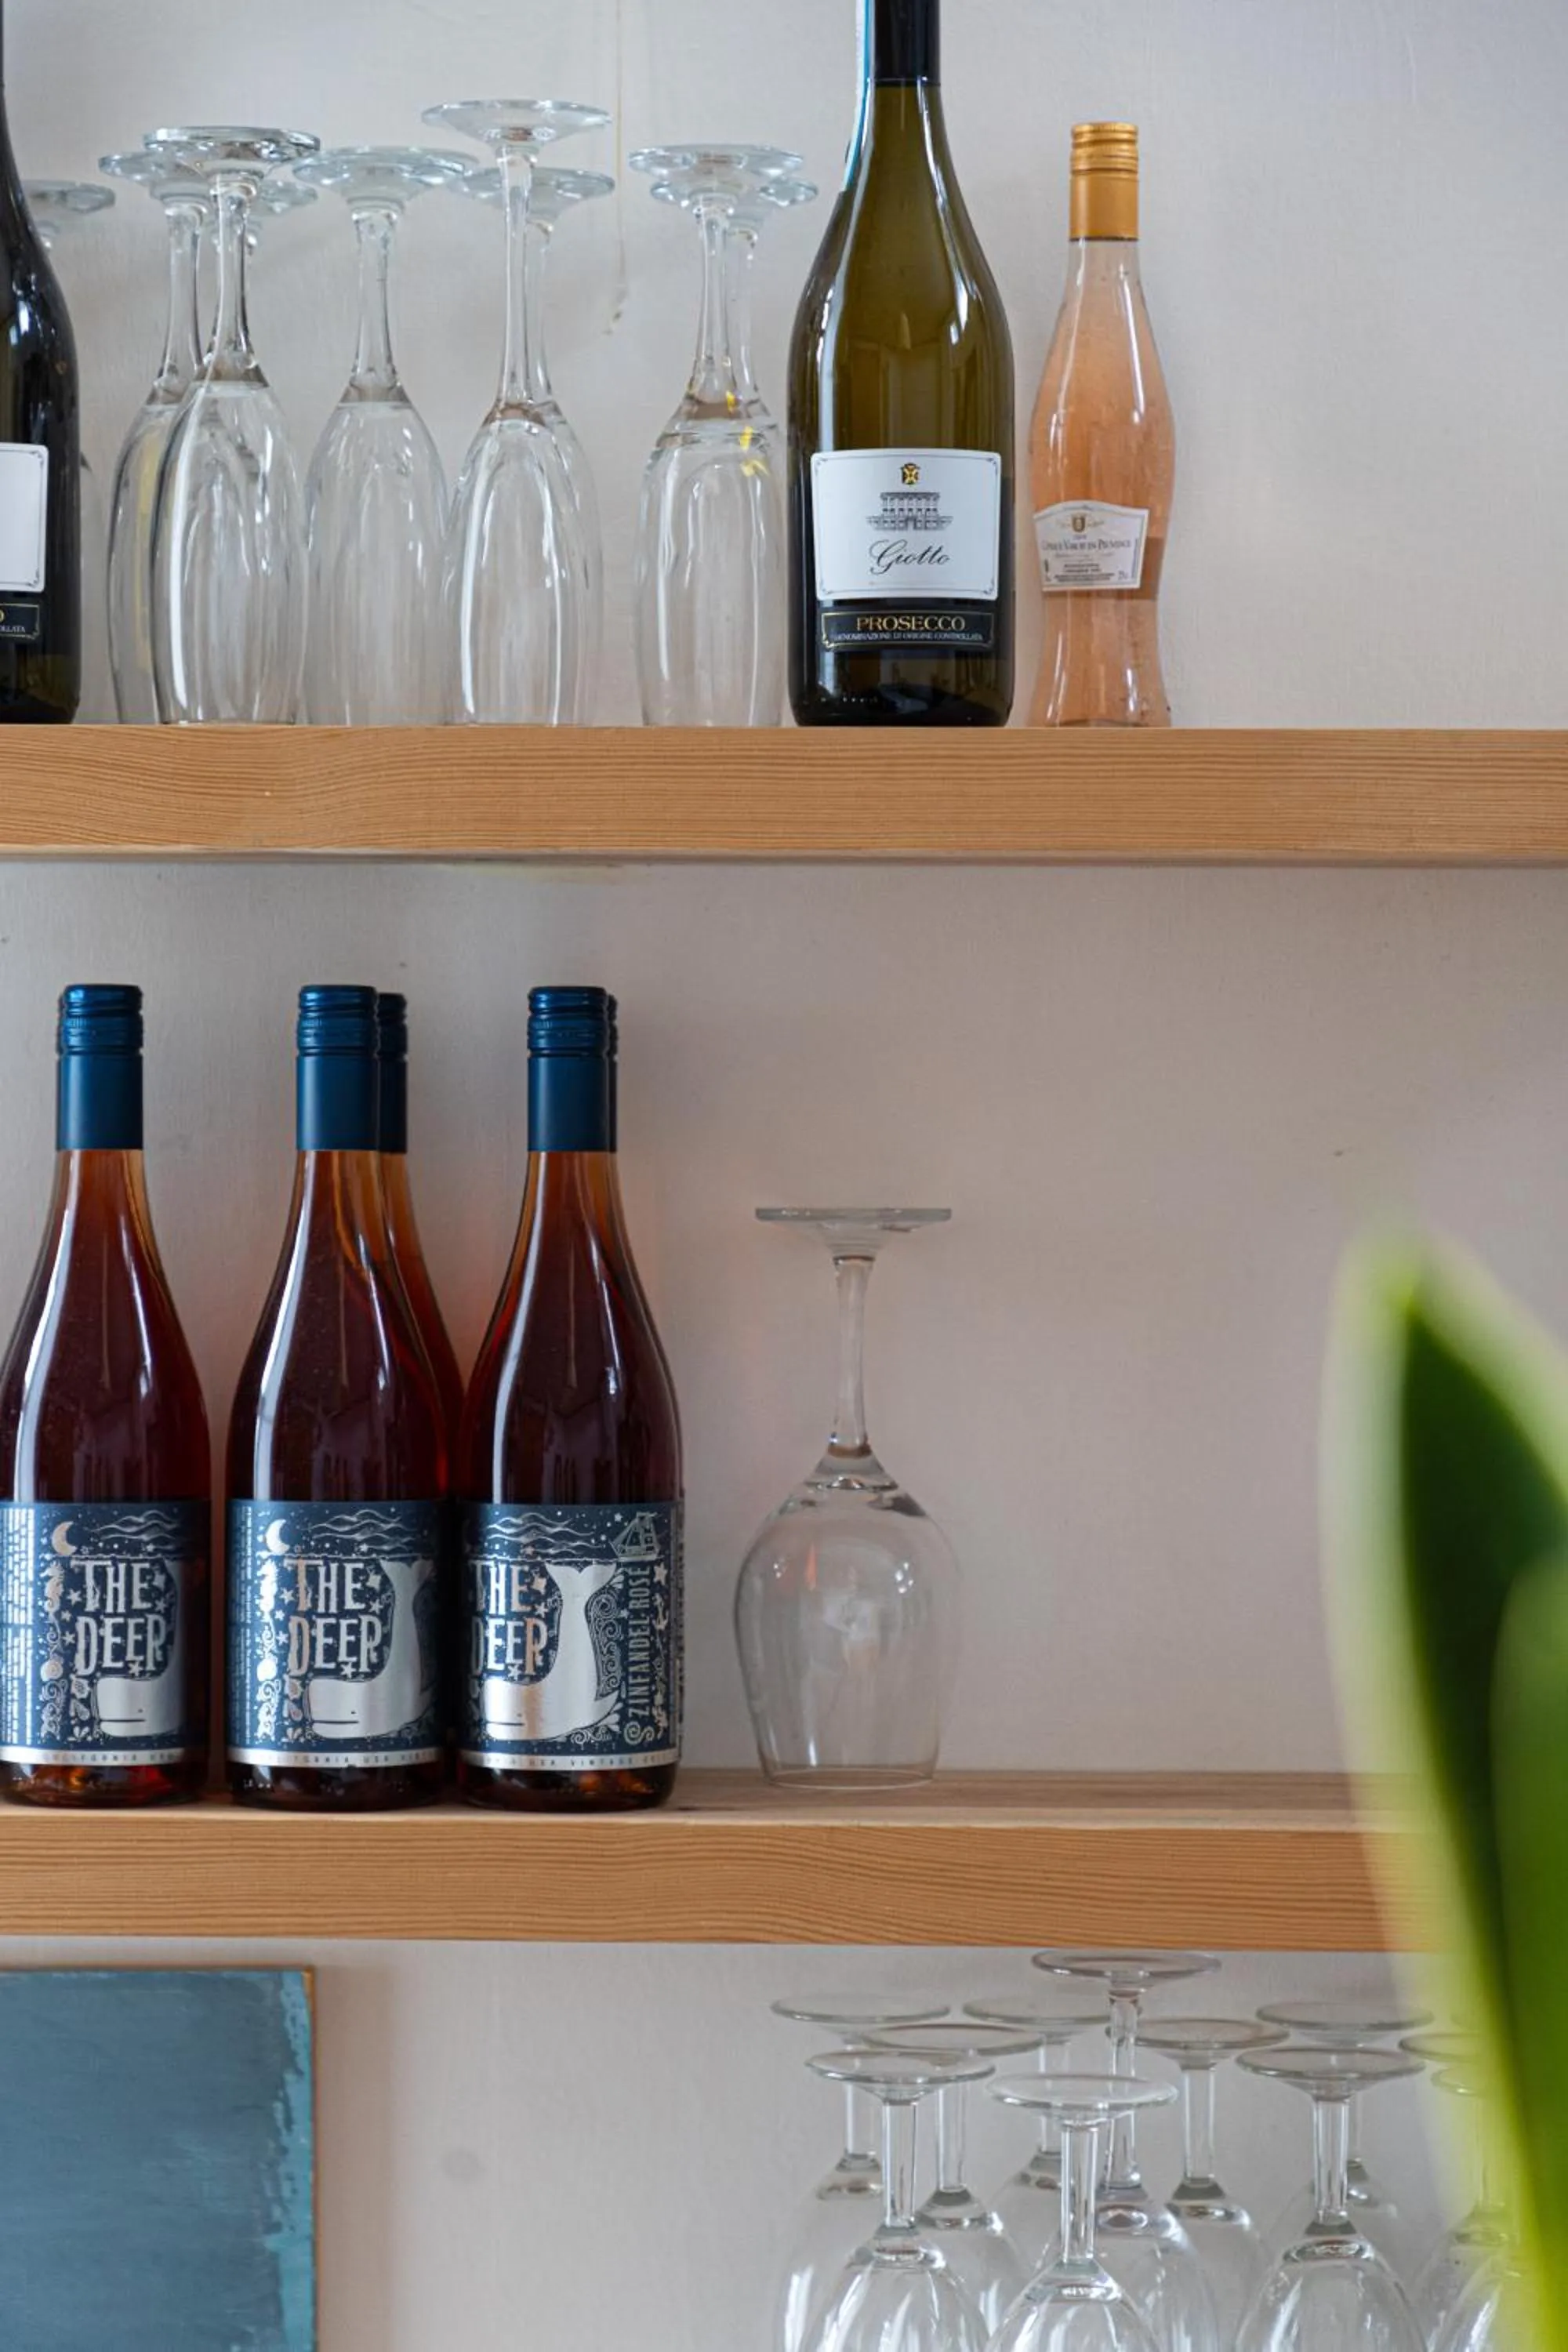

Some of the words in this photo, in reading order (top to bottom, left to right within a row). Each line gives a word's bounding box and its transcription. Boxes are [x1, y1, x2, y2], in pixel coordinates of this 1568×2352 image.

[869, 539, 951, 575] Giotto
[856, 615, 966, 631] PROSECCO
[71, 1559, 153, 1613] THE
[283, 1558, 366, 1615] THE
[470, 1559, 532, 1616] THE
[74, 1614, 166, 1677] DEEP
[287, 1614, 383, 1677] DEEP
[471, 1616, 549, 1676] DEEP
[628, 1614, 651, 1719] ZINFANDEL
